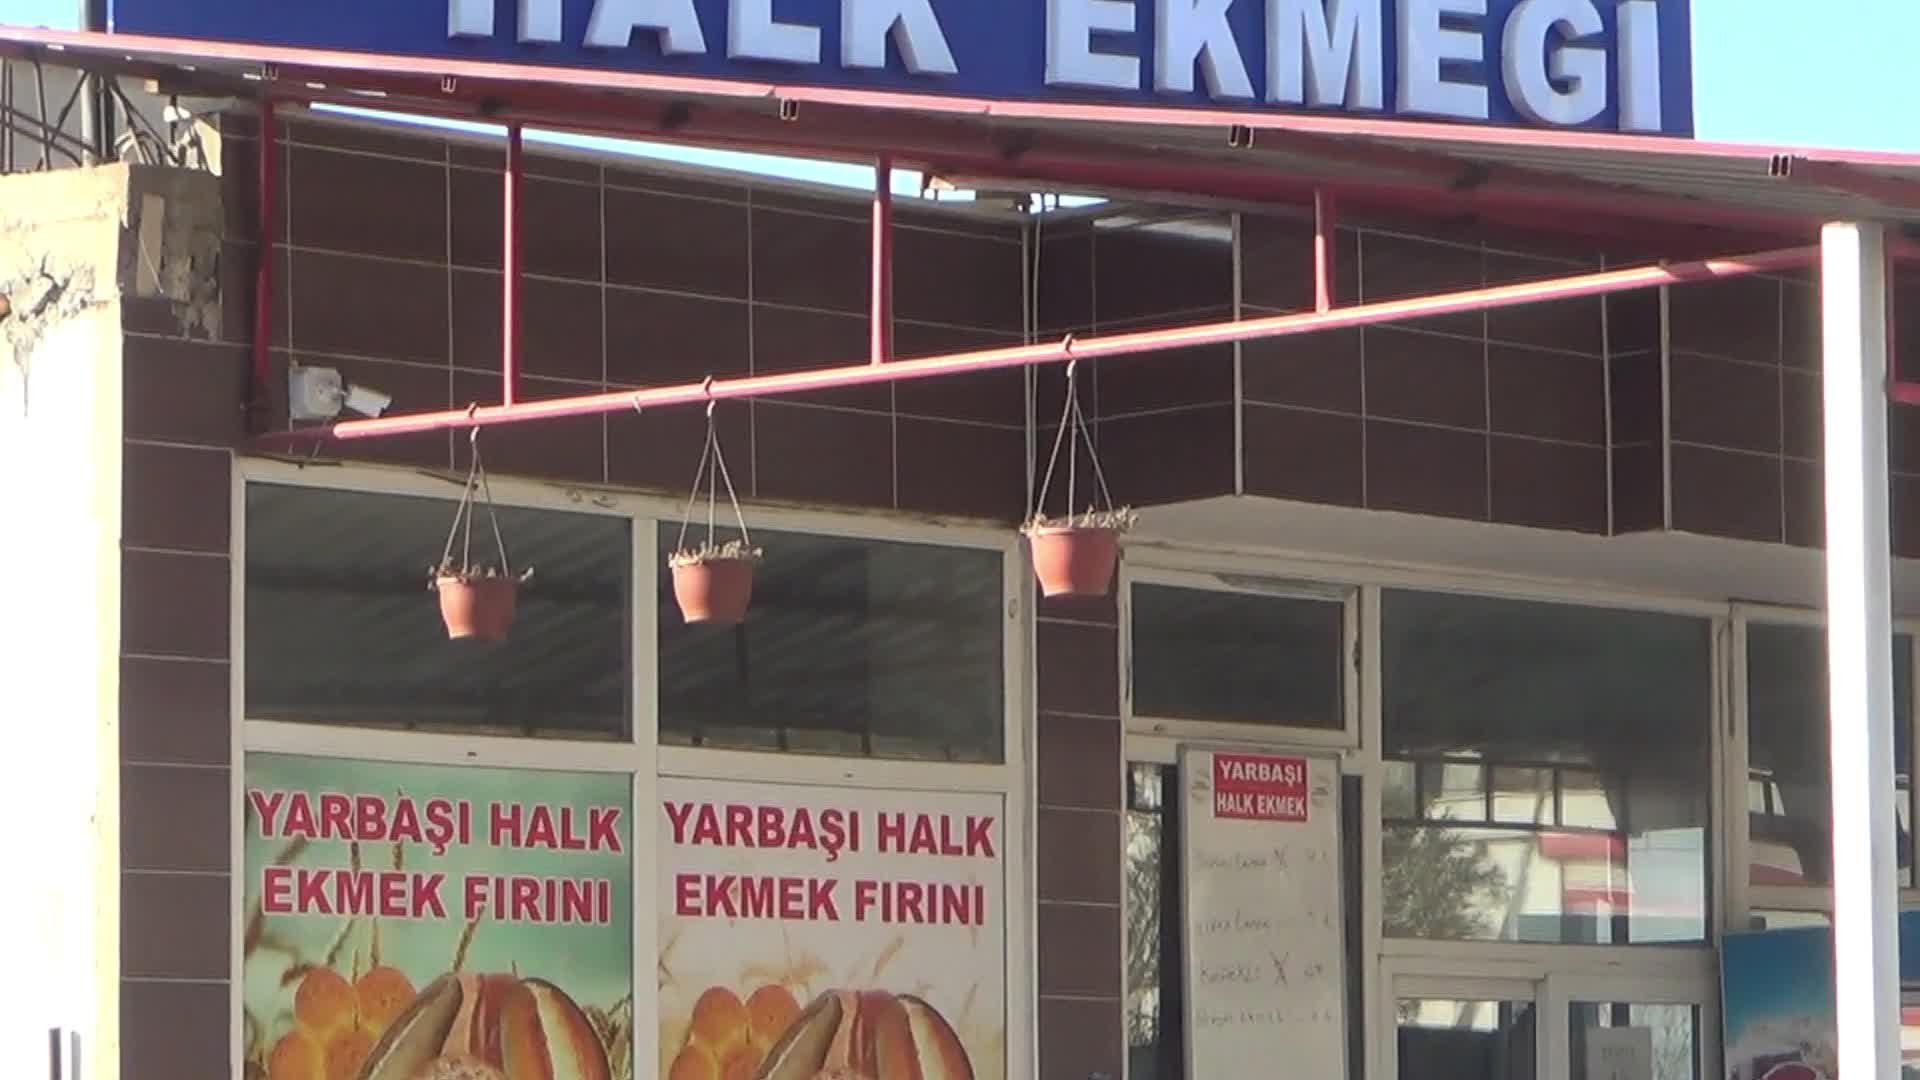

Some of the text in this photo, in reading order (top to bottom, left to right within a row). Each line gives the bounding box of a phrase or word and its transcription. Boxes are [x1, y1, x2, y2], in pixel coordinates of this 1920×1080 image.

[1219, 760, 1303, 787] YARBAŞI
[250, 791, 623, 856] YARBAŞI HALK
[1216, 791, 1305, 817] HALK EKMEK
[664, 801, 995, 862] YARBAŞI HALK
[264, 868, 609, 924] EKMEK FIRINI
[676, 874, 984, 926] EKMEK FIRINI
